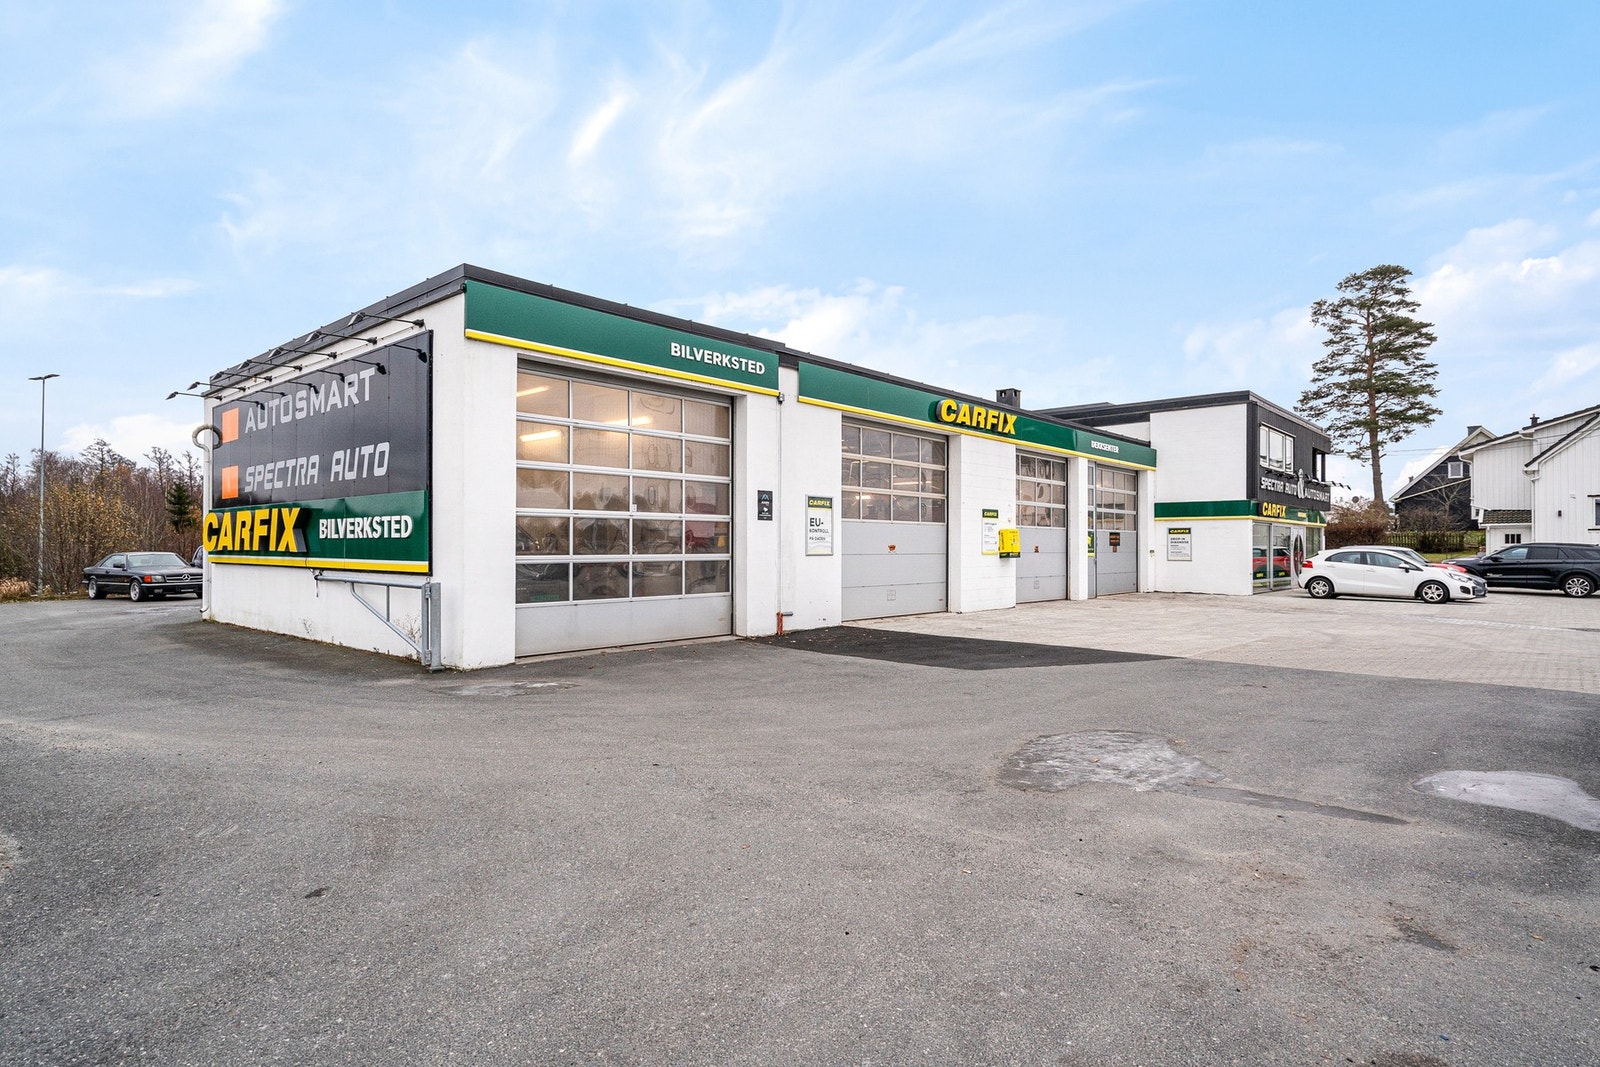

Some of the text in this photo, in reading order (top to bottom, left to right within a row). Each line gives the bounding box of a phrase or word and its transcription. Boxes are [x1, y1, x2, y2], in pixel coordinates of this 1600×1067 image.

[670, 342, 765, 374] BILVERKSTED
[244, 367, 375, 433] AUTOSMART
[940, 399, 1017, 435] CARFIX
[244, 441, 390, 493] SPECTRA AUTO
[1261, 477, 1284, 492] SPECTRA
[809, 517, 824, 527] EU-
[1262, 502, 1286, 518] CARFIX
[202, 507, 301, 552] CARFIX
[319, 515, 413, 539] BILVERKSTED
